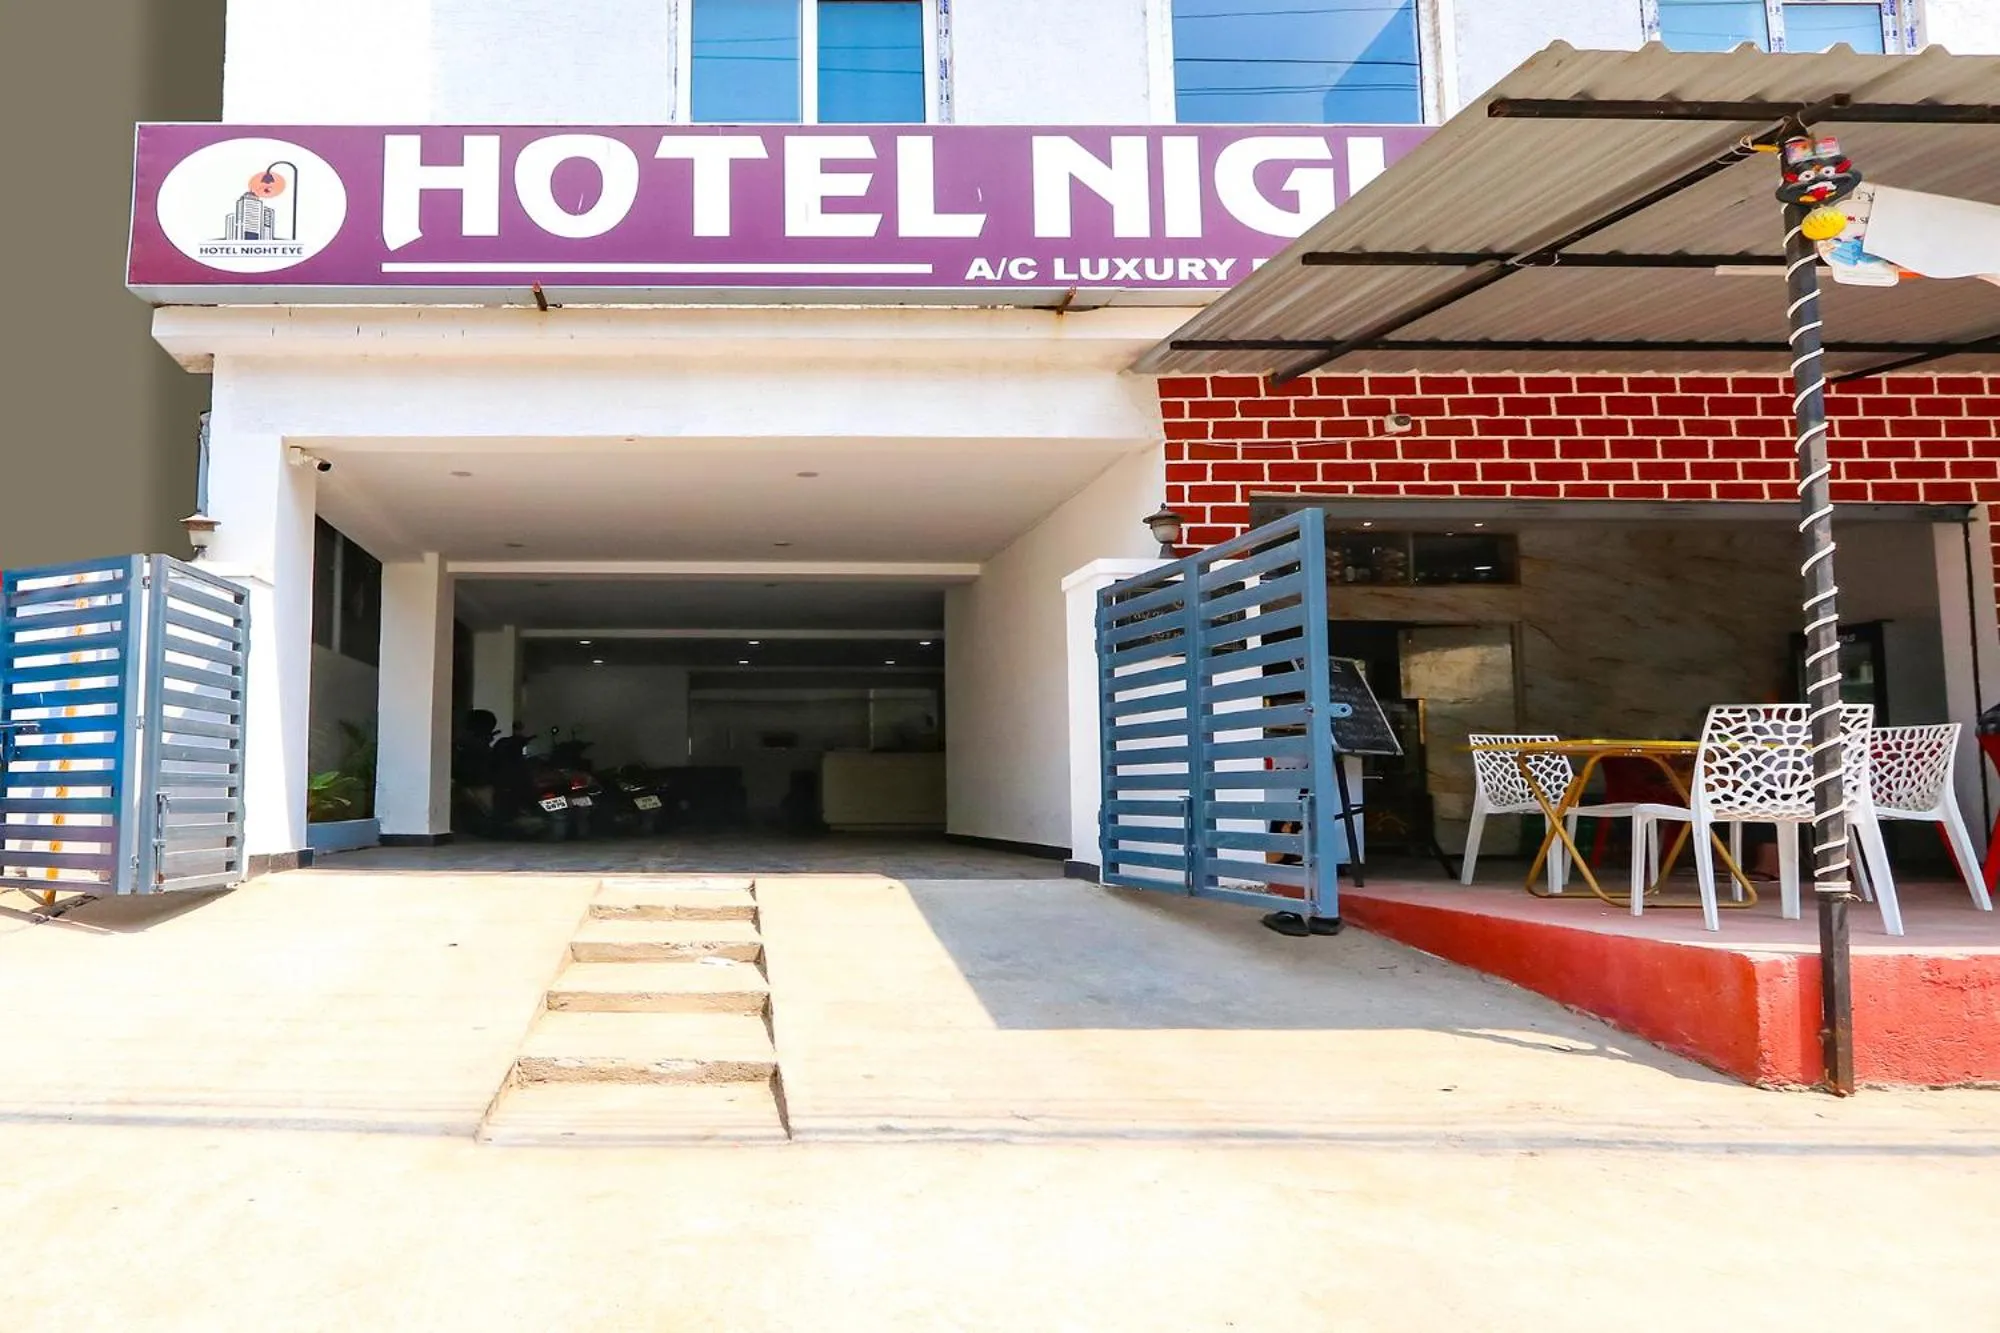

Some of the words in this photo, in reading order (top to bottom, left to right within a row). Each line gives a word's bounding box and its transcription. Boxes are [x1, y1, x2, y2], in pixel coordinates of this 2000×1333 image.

[382, 133, 987, 251] HOTEL
[199, 246, 238, 255] HOTEL
[240, 246, 279, 255] NIGHT
[281, 246, 304, 255] EYE
[964, 257, 1039, 281] A/C
[1053, 257, 1237, 281] LUXURY
